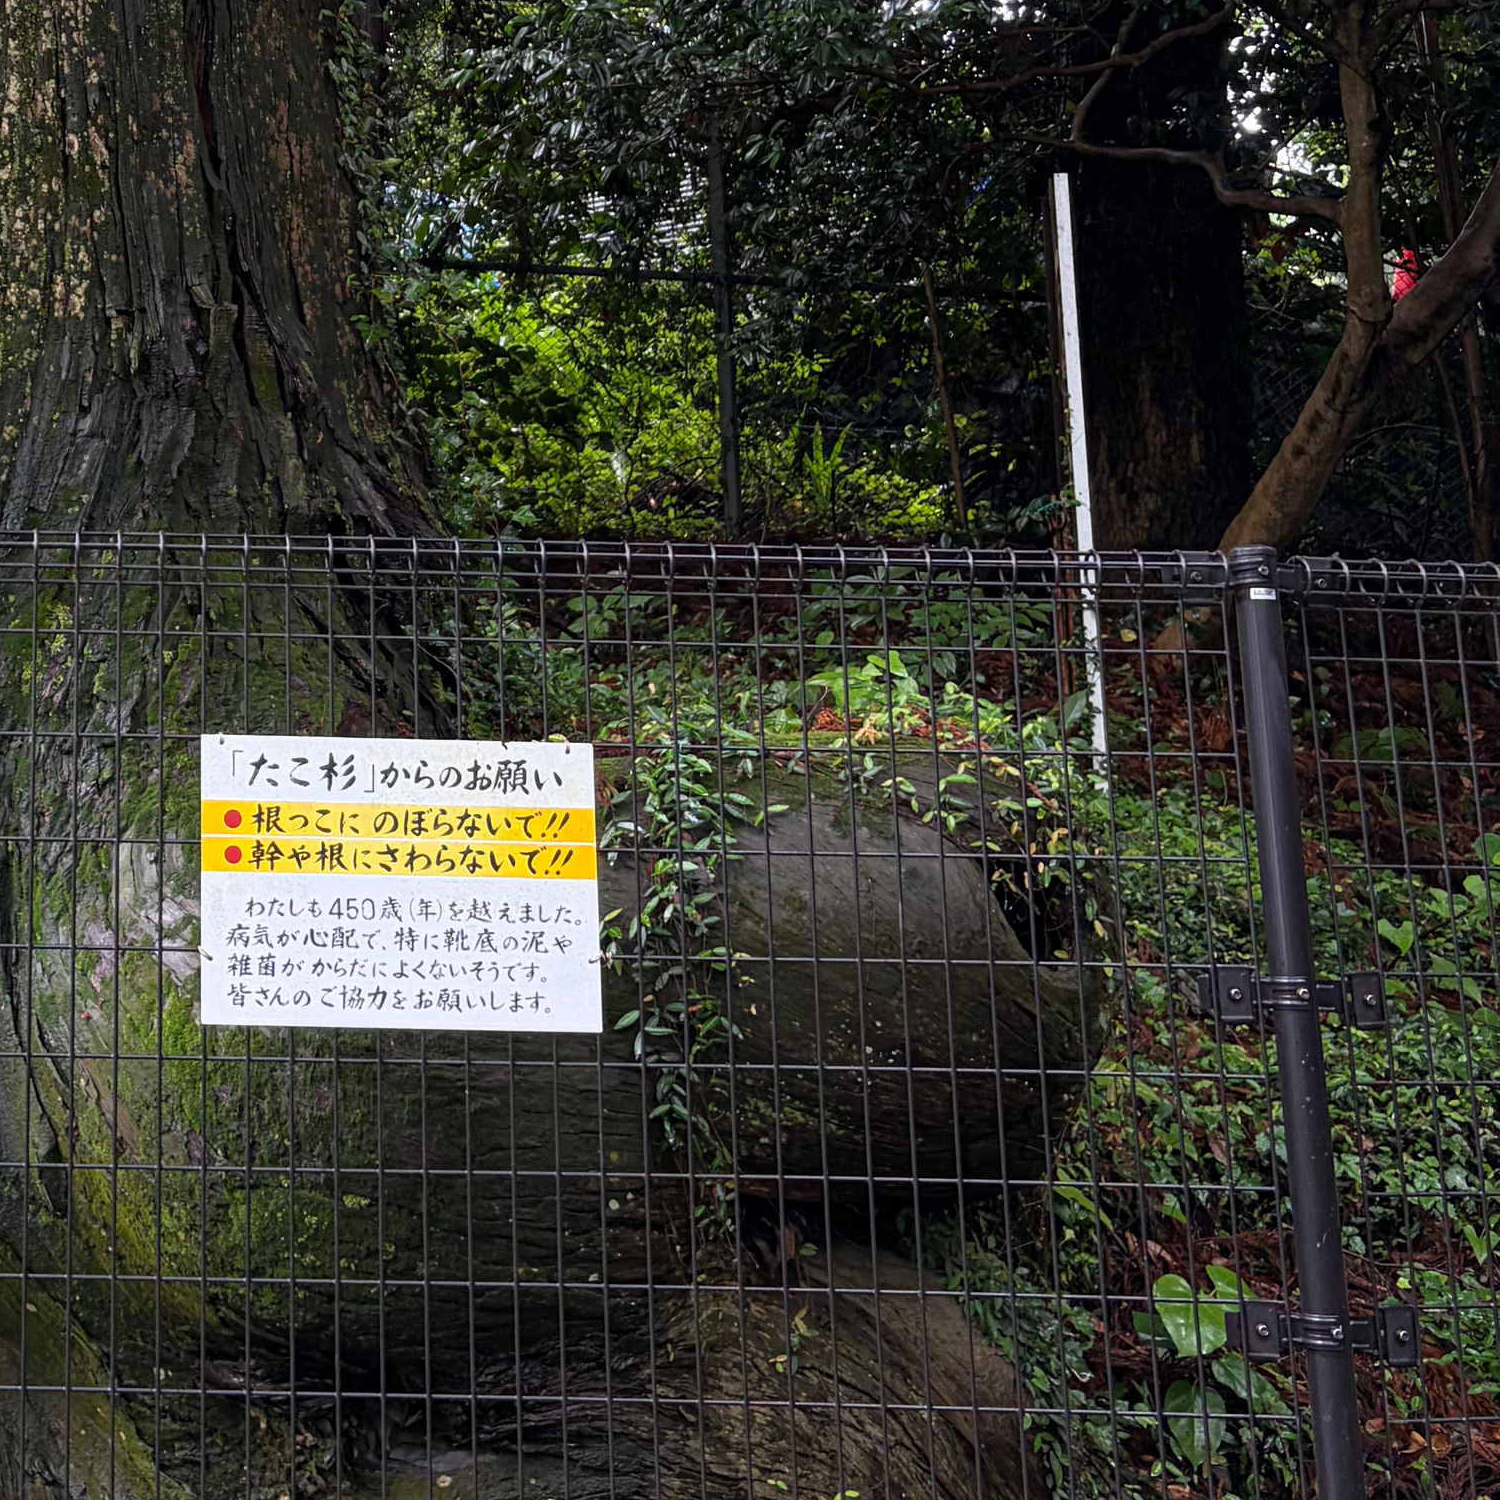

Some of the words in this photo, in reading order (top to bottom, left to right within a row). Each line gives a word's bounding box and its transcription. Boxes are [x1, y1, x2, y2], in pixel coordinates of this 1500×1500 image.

[232, 750, 563, 795] 「たこ杉」からのお願い
[244, 896, 582, 926] わたしも450歳（年）を越えました。
[225, 923, 573, 954] 病気が心配で、特に靴底の泥や
[226, 952, 547, 982] 雑菌がからだによくないそうです。
[226, 982, 551, 1014] 皆さんのご協力をお願いします。
